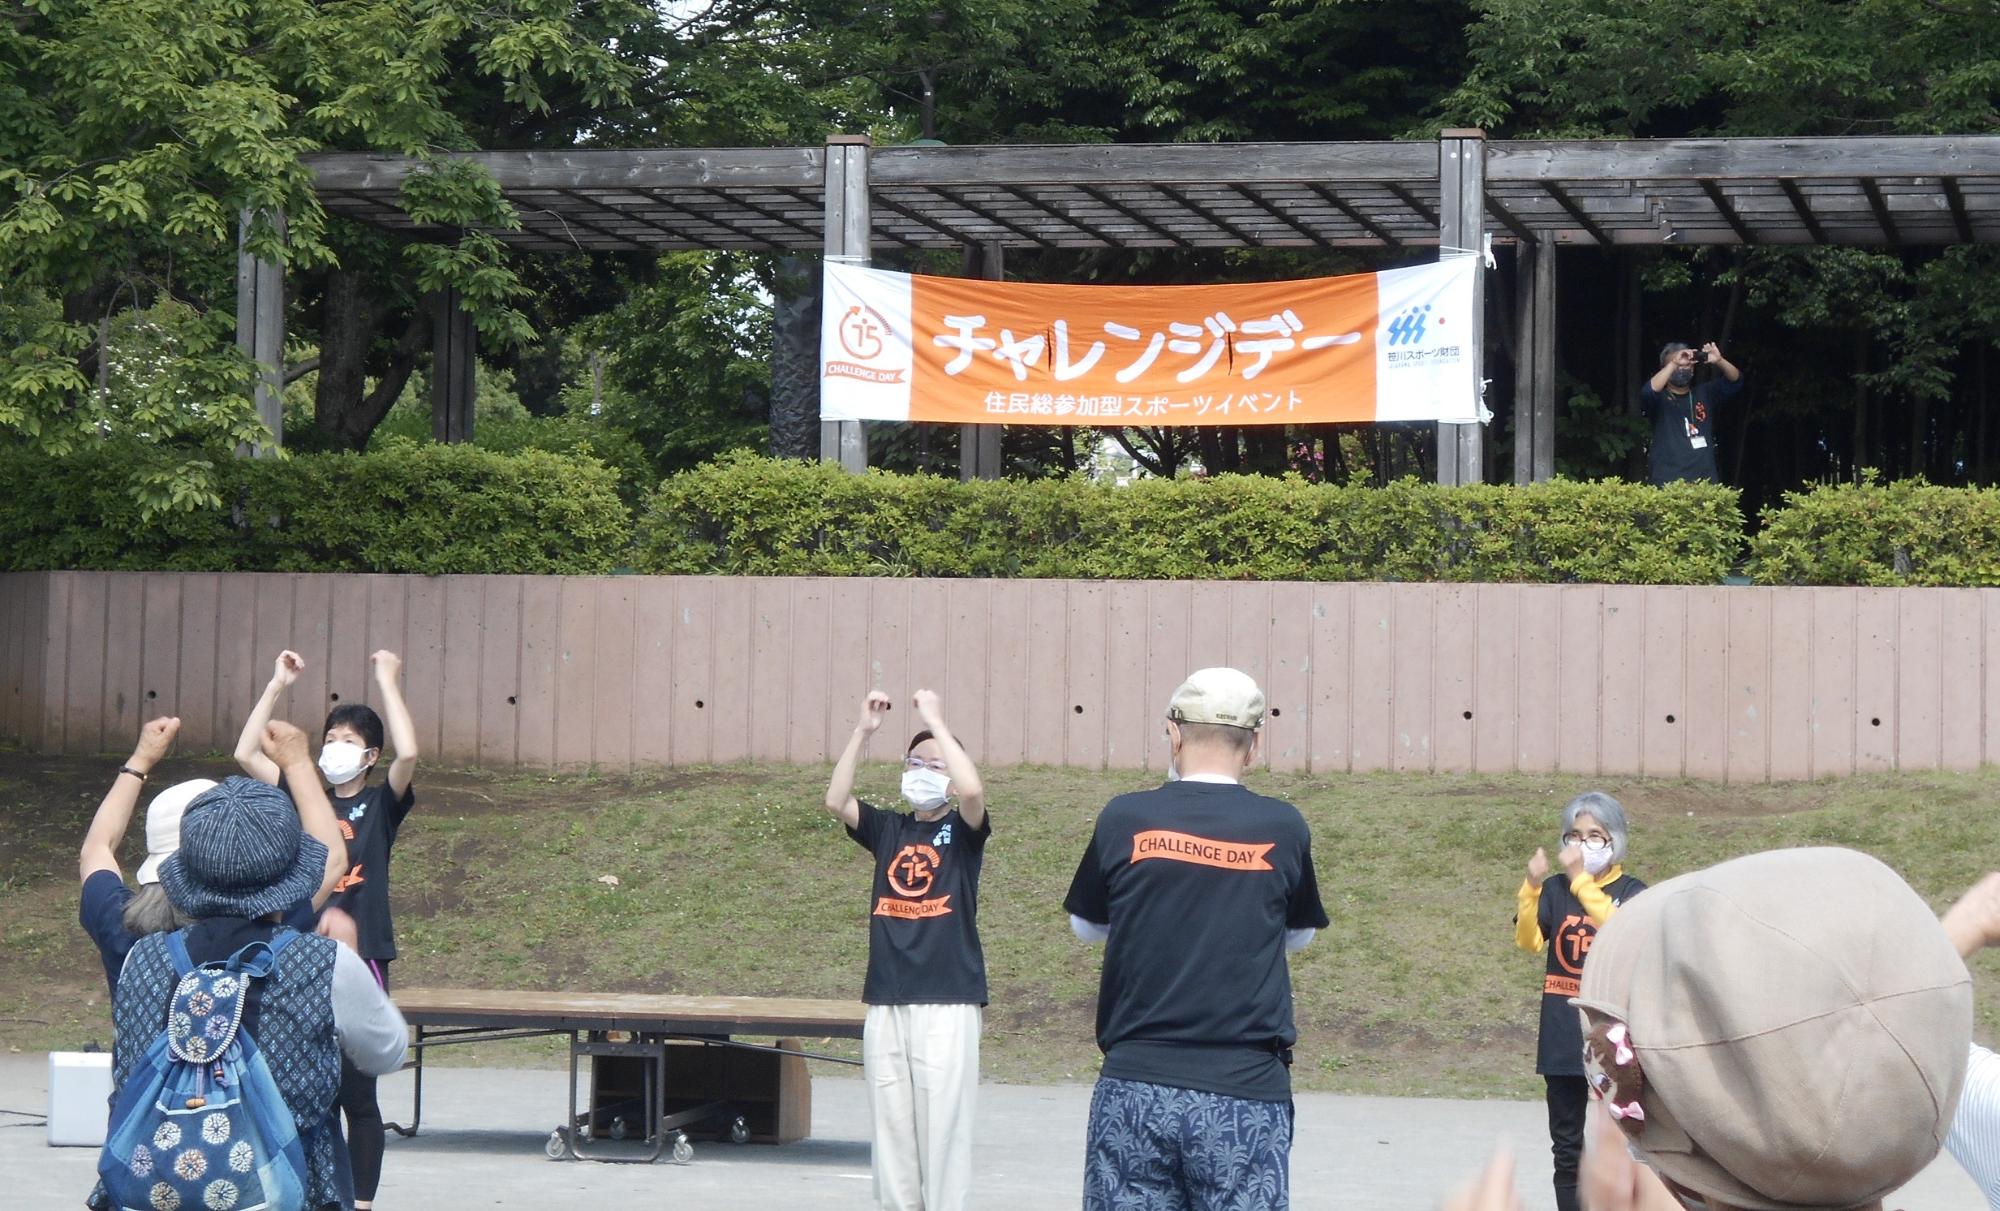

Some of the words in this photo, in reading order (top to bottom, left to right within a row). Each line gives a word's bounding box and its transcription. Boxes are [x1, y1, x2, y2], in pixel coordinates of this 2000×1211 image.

[932, 309, 1362, 383] チャレンジデー
[1388, 346, 1460, 362] 笹川スポーツ財団
[827, 363, 877, 379] CHALLENGE
[877, 372, 897, 381] DAY
[984, 389, 1302, 417] 住民総参加型スポーツイベント
[1138, 837, 1222, 861] CHALLENGE
[1226, 849, 1256, 864] DAY
[921, 903, 939, 914] DAY
